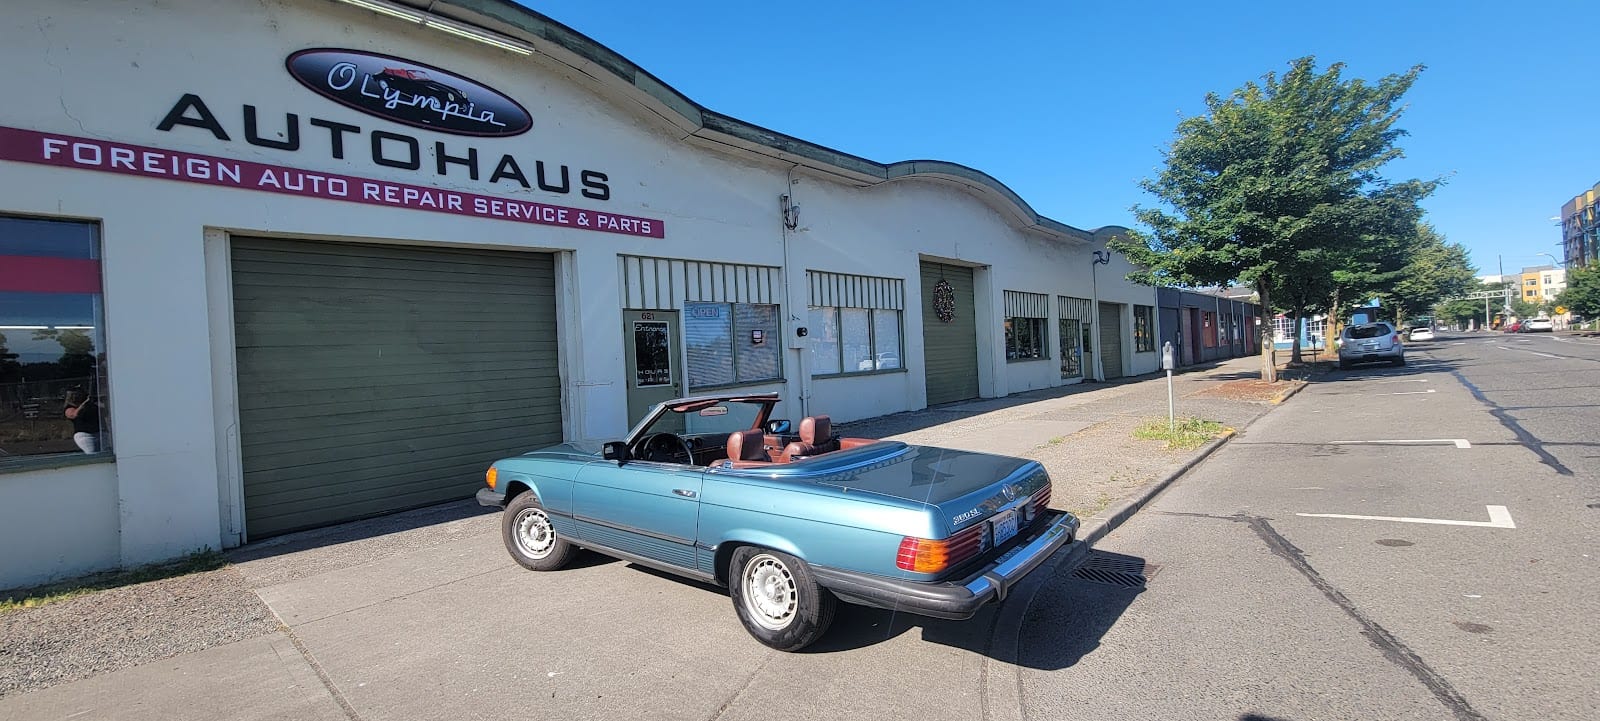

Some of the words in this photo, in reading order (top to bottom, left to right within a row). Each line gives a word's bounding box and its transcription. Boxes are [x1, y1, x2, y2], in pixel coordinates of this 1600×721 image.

[156, 93, 611, 201] AUTOHAUS
[42, 137, 241, 184] FOREIGN
[257, 168, 348, 197] AUTO
[363, 182, 463, 212] REPAIR
[474, 198, 569, 224] SERVICE
[577, 212, 590, 227] &
[597, 215, 651, 234] PARTS
[641, 312, 655, 320] 621
[692, 307, 719, 317] OPEN
